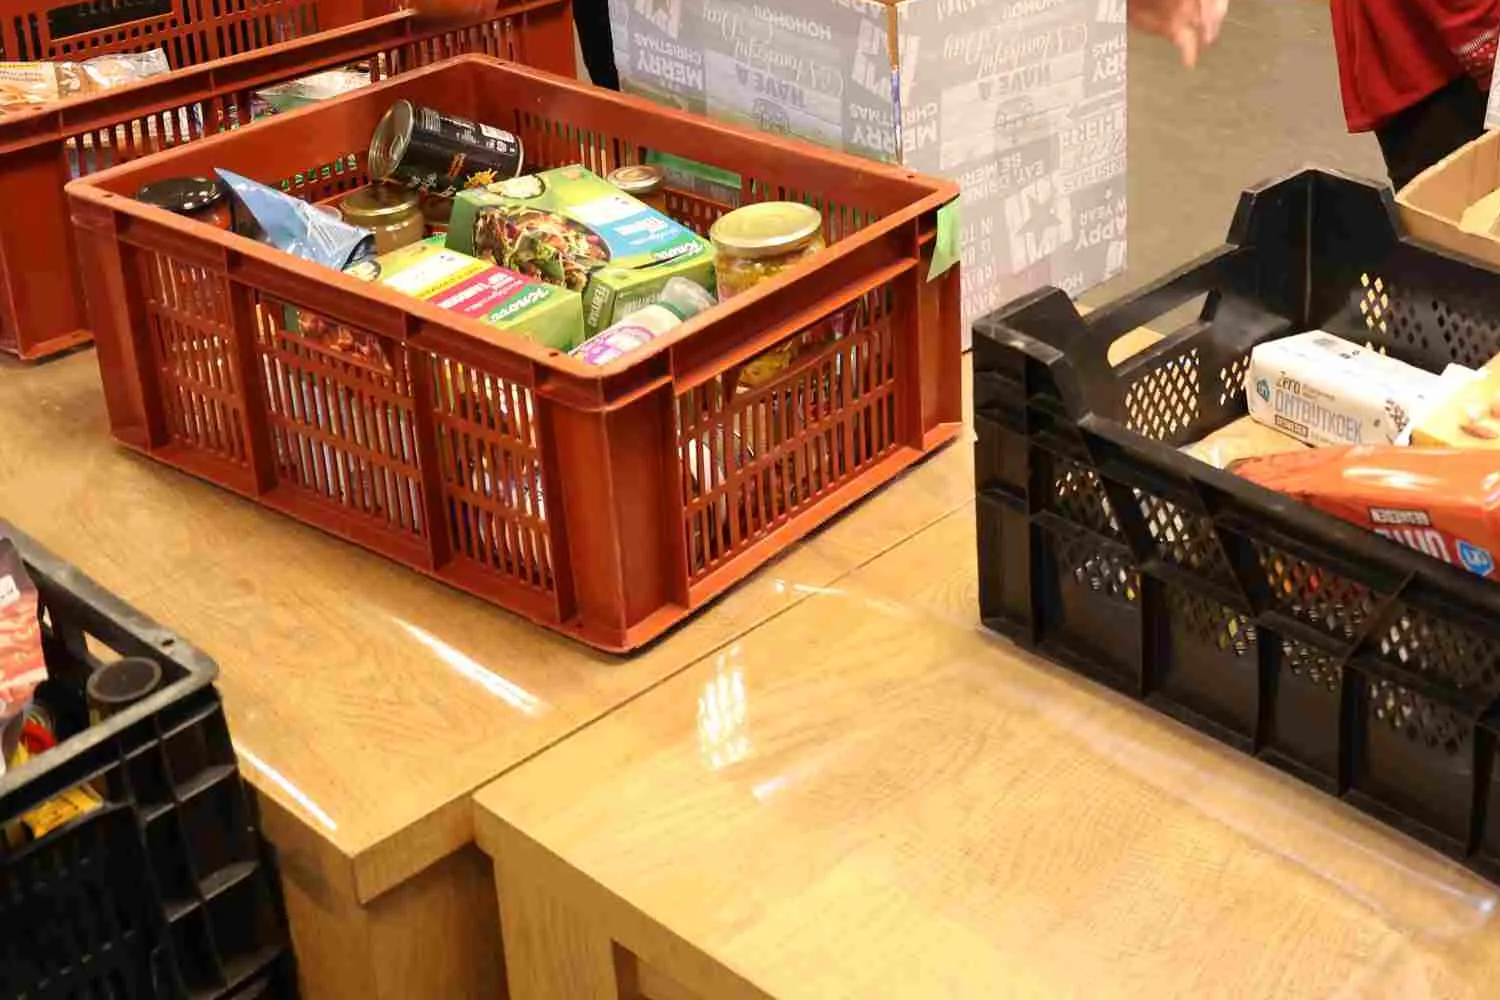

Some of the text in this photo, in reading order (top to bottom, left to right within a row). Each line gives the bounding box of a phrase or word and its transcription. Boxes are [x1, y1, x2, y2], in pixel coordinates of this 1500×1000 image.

[634, 32, 702, 66] CHRISTMAS
[636, 50, 703, 91] MERRY
[754, 73, 804, 108] HAVE
[958, 160, 998, 187] MERR
[1074, 212, 1126, 251] APPY
